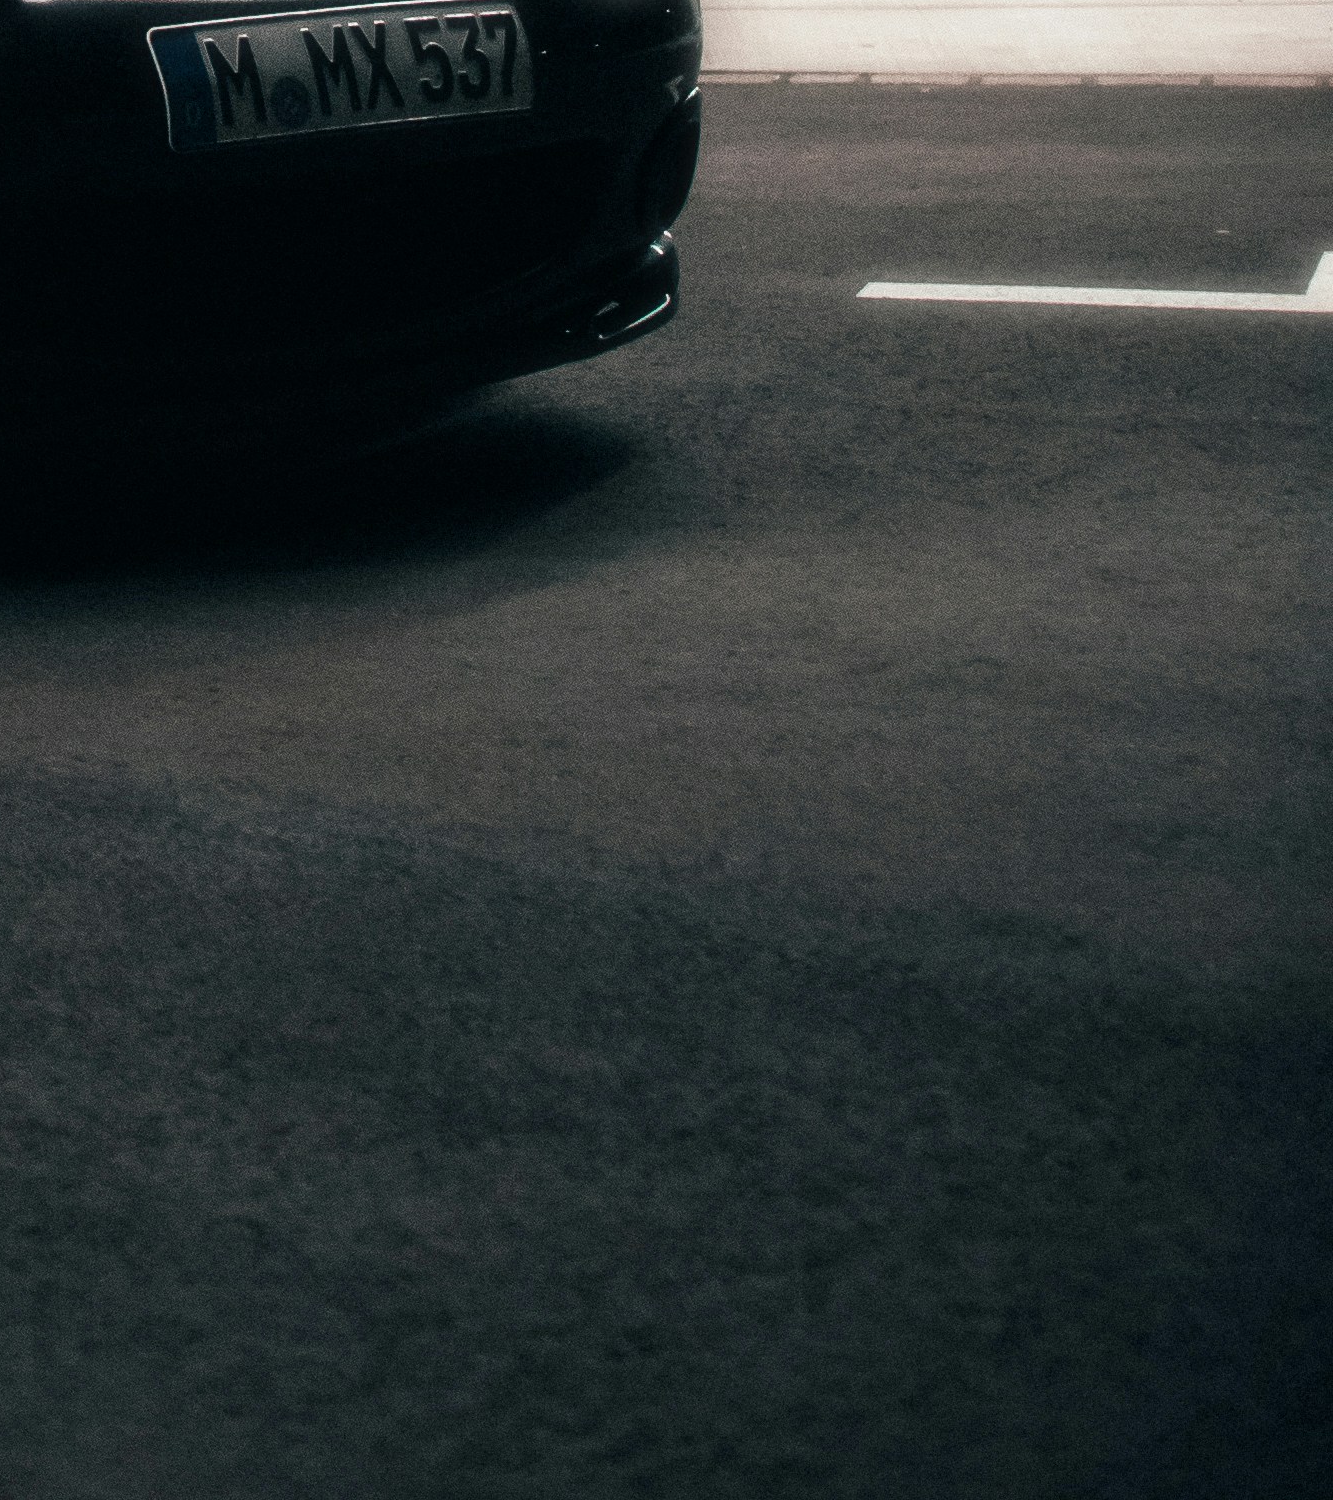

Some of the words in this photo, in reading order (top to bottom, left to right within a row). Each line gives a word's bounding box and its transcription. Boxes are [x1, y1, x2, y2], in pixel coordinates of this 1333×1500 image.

[202, 33, 268, 127] M
[299, 19, 406, 117] MX
[403, 9, 518, 104] 537
